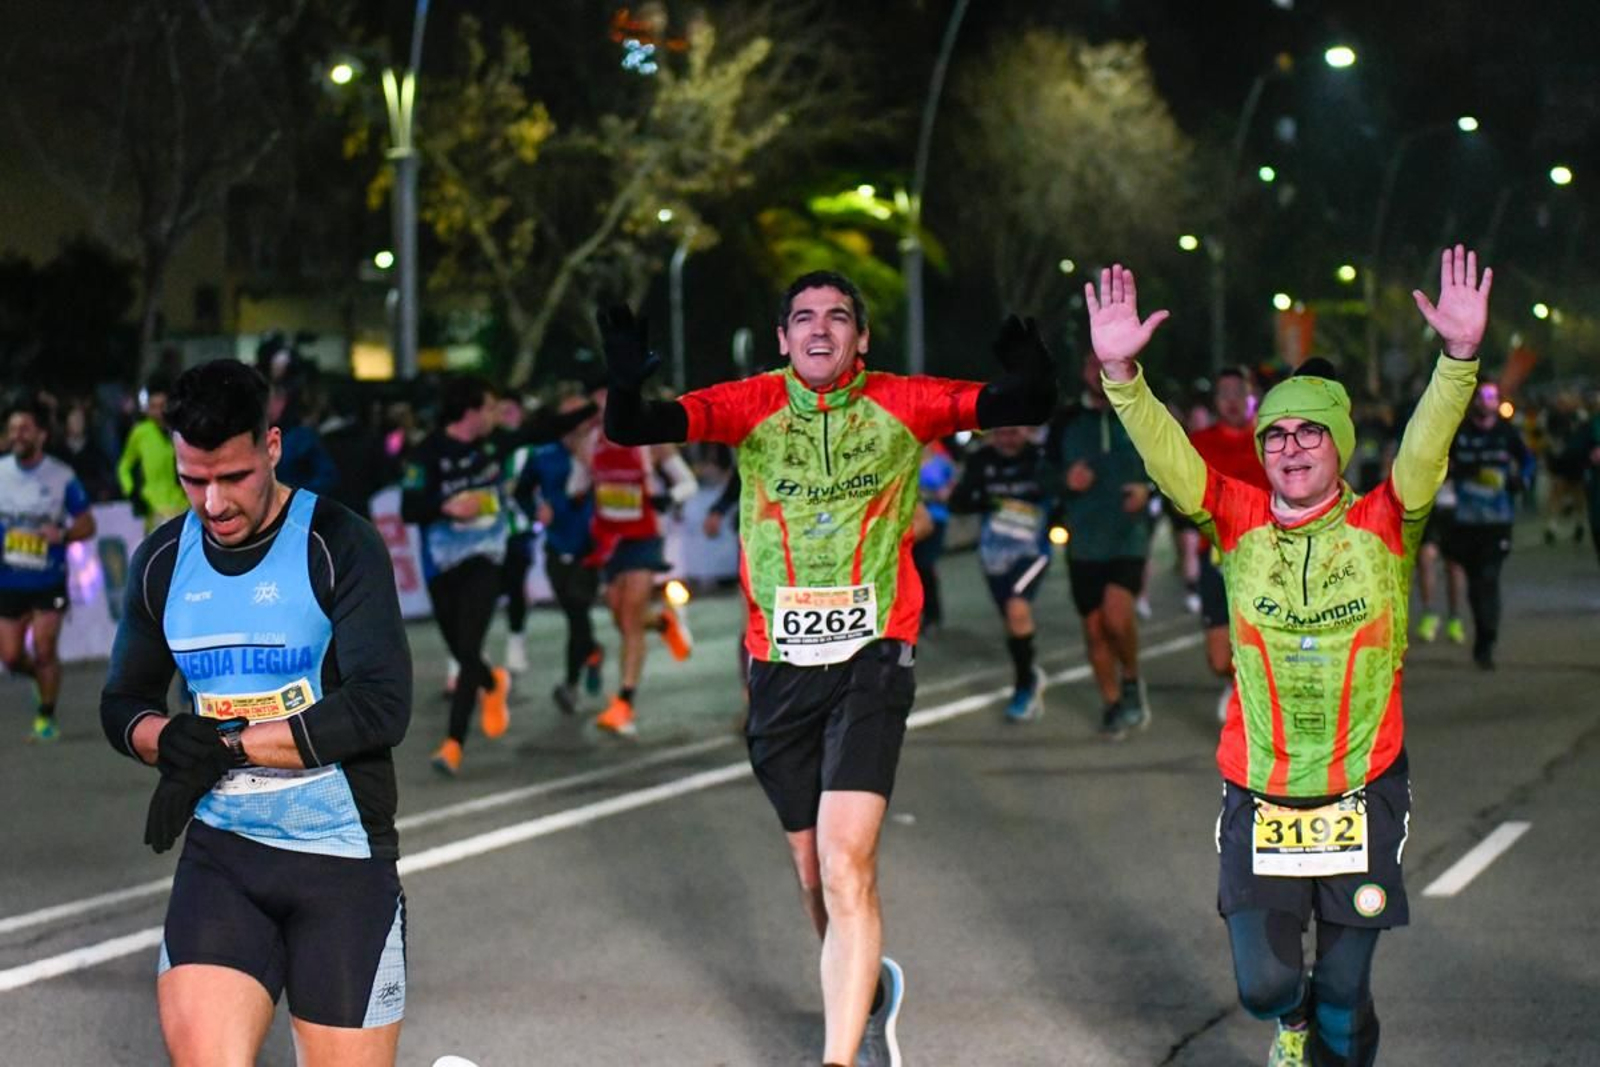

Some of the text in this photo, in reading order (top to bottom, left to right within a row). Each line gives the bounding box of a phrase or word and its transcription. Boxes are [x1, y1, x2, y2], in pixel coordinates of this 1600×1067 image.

[783, 608, 867, 635] 6262
[241, 646, 312, 675] LEGUA
[1265, 816, 1355, 844] 3192
